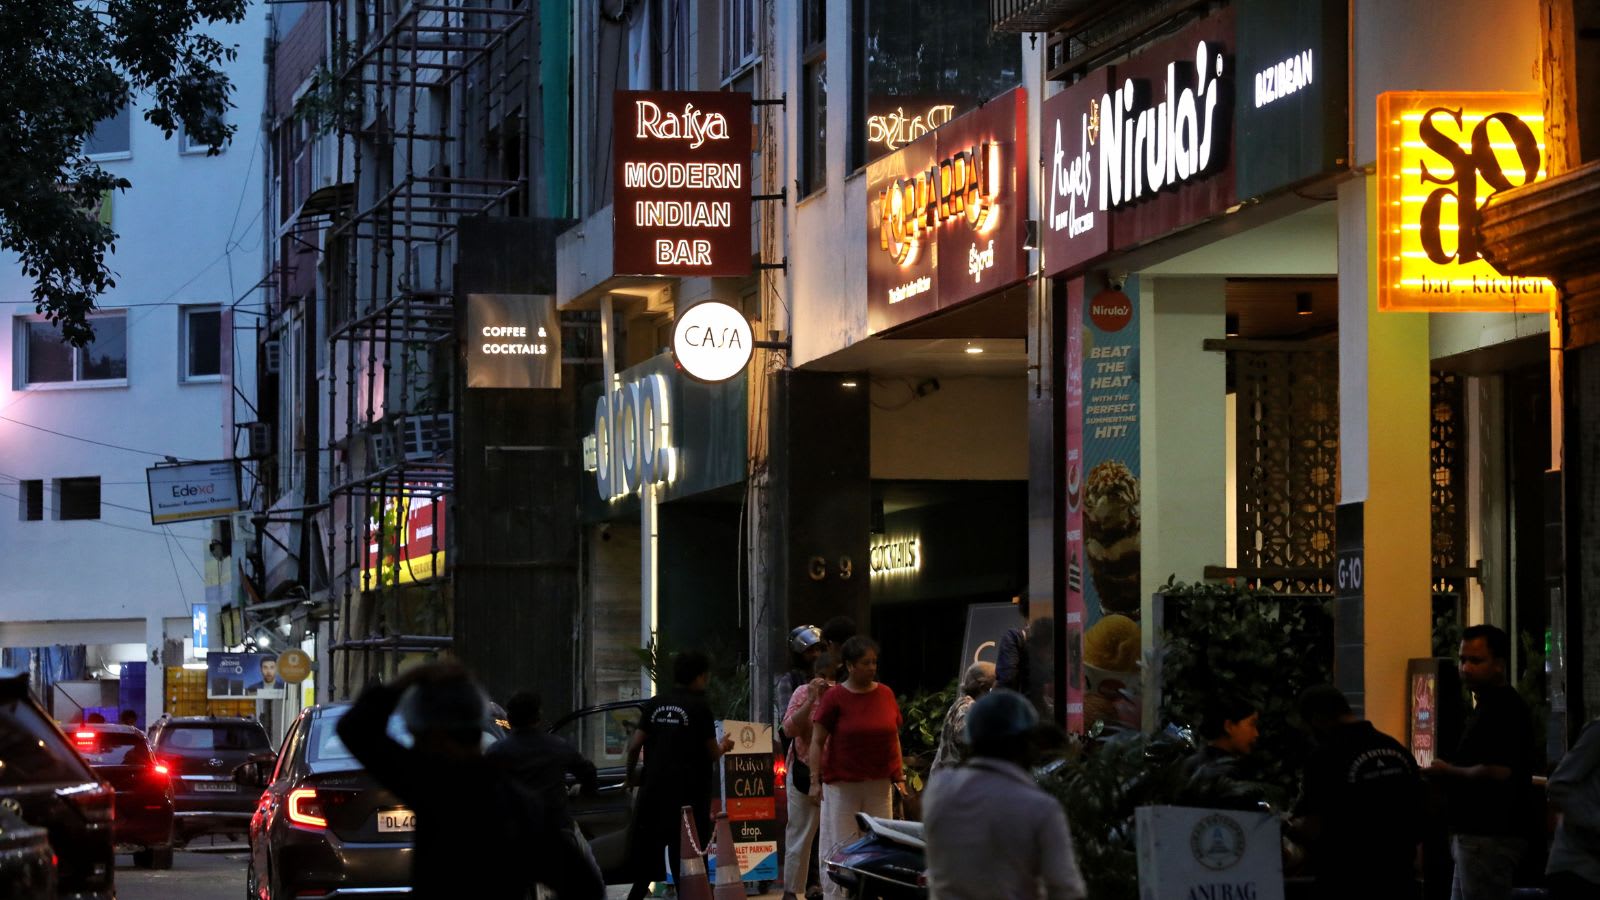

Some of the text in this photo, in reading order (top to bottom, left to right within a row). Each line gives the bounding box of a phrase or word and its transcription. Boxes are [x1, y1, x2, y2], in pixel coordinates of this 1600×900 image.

[1255, 48, 1312, 108] BIZIBEAN
[635, 100, 730, 149] Raiya
[1100, 40, 1217, 211] Nirula's
[624, 162, 741, 189] MODERN
[1050, 113, 1091, 238] Angels
[635, 201, 731, 227] INDIAN
[656, 239, 712, 265] BAR
[1421, 274, 1452, 294] bar
[1473, 274, 1544, 294] kitchen
[1092, 305, 1129, 316] Nirula's
[482, 326, 547, 337] COFFEE &
[684, 325, 742, 349] CASA
[482, 344, 547, 355] COCKTAILS
[1090, 345, 1131, 359] BEAT
[1096, 361, 1126, 374] THE
[1090, 375, 1132, 390] HEAT
[1091, 394, 1130, 403] WITH THE
[1086, 403, 1136, 415] PERFECT
[1085, 414, 1137, 425] SUMMERTIME
[1094, 425, 1128, 440] HIT!
[870, 540, 917, 573] COCKTAILS
[809, 556, 852, 581] G 9
[1338, 557, 1362, 590] G-10
[735, 777, 765, 797] CASA
[741, 820, 762, 842] drop.
[749, 845, 773, 854] PARKING
[1188, 881, 1256, 900] ANURAG
